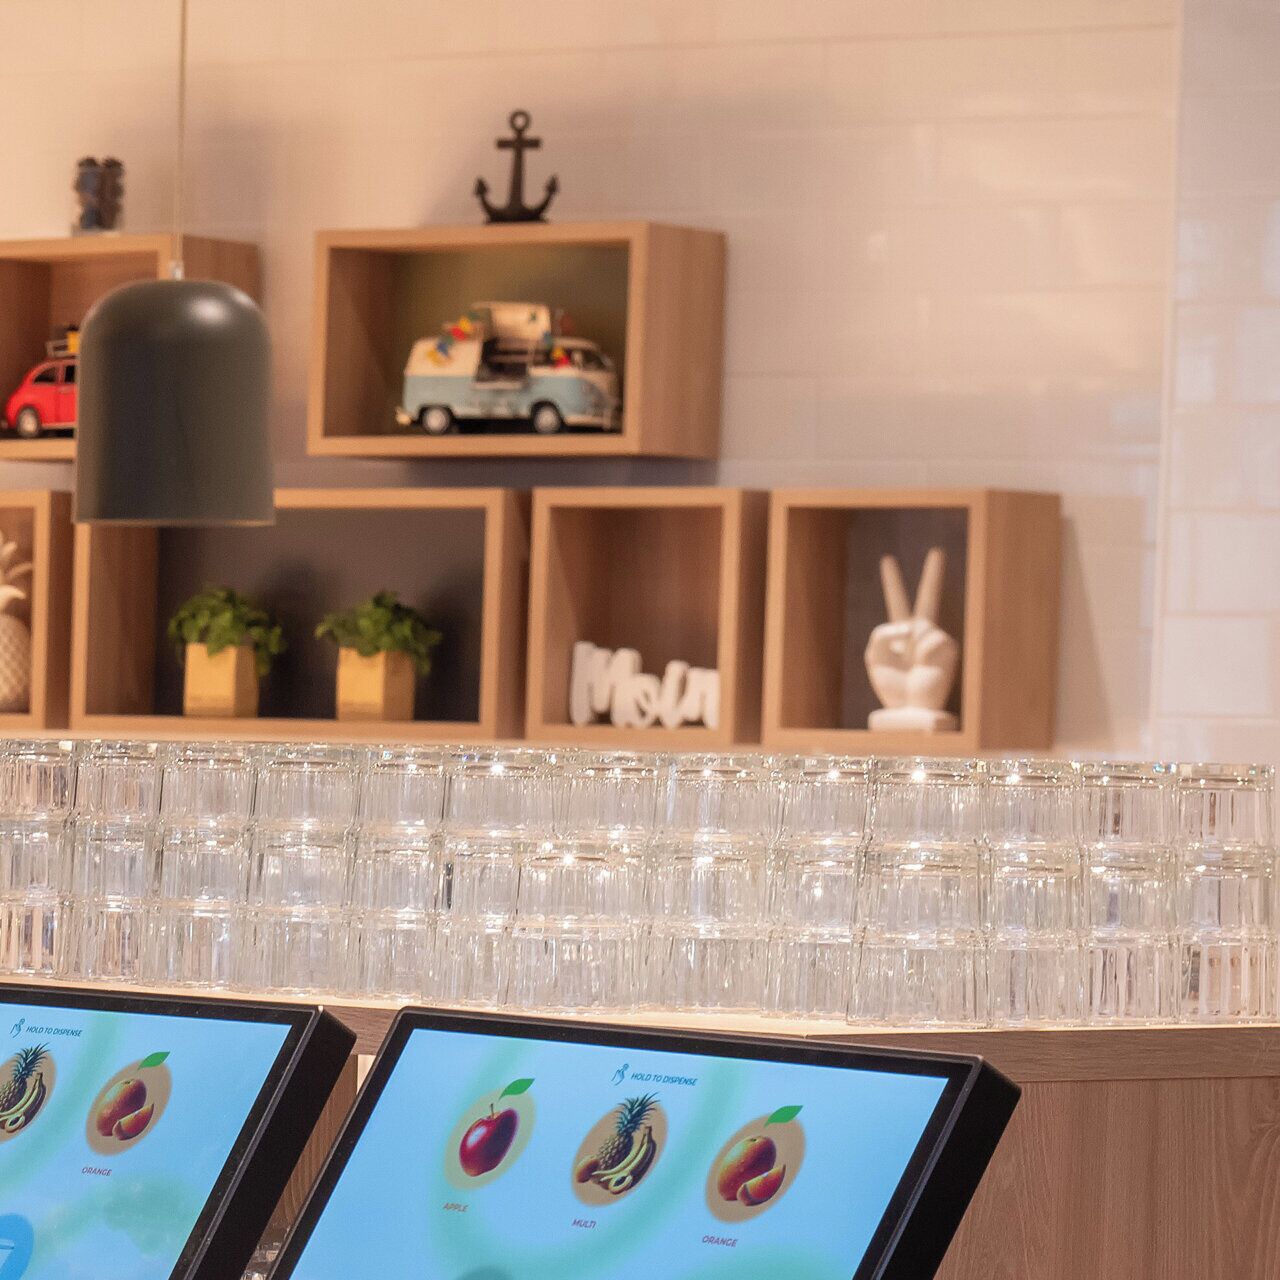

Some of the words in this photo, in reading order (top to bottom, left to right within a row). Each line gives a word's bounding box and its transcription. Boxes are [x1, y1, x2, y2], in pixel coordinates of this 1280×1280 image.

[26, 1026, 44, 1034] HOLD
[53, 1028, 83, 1037] DISPENSE
[631, 1073, 651, 1081] HOLD
[653, 1074, 662, 1083] TO
[662, 1076, 698, 1086] DISPENSE
[81, 1167, 112, 1177] ORANGE
[443, 1203, 468, 1212] APPLE
[572, 1219, 597, 1229] MULTI
[702, 1235, 738, 1248] ORANGE
